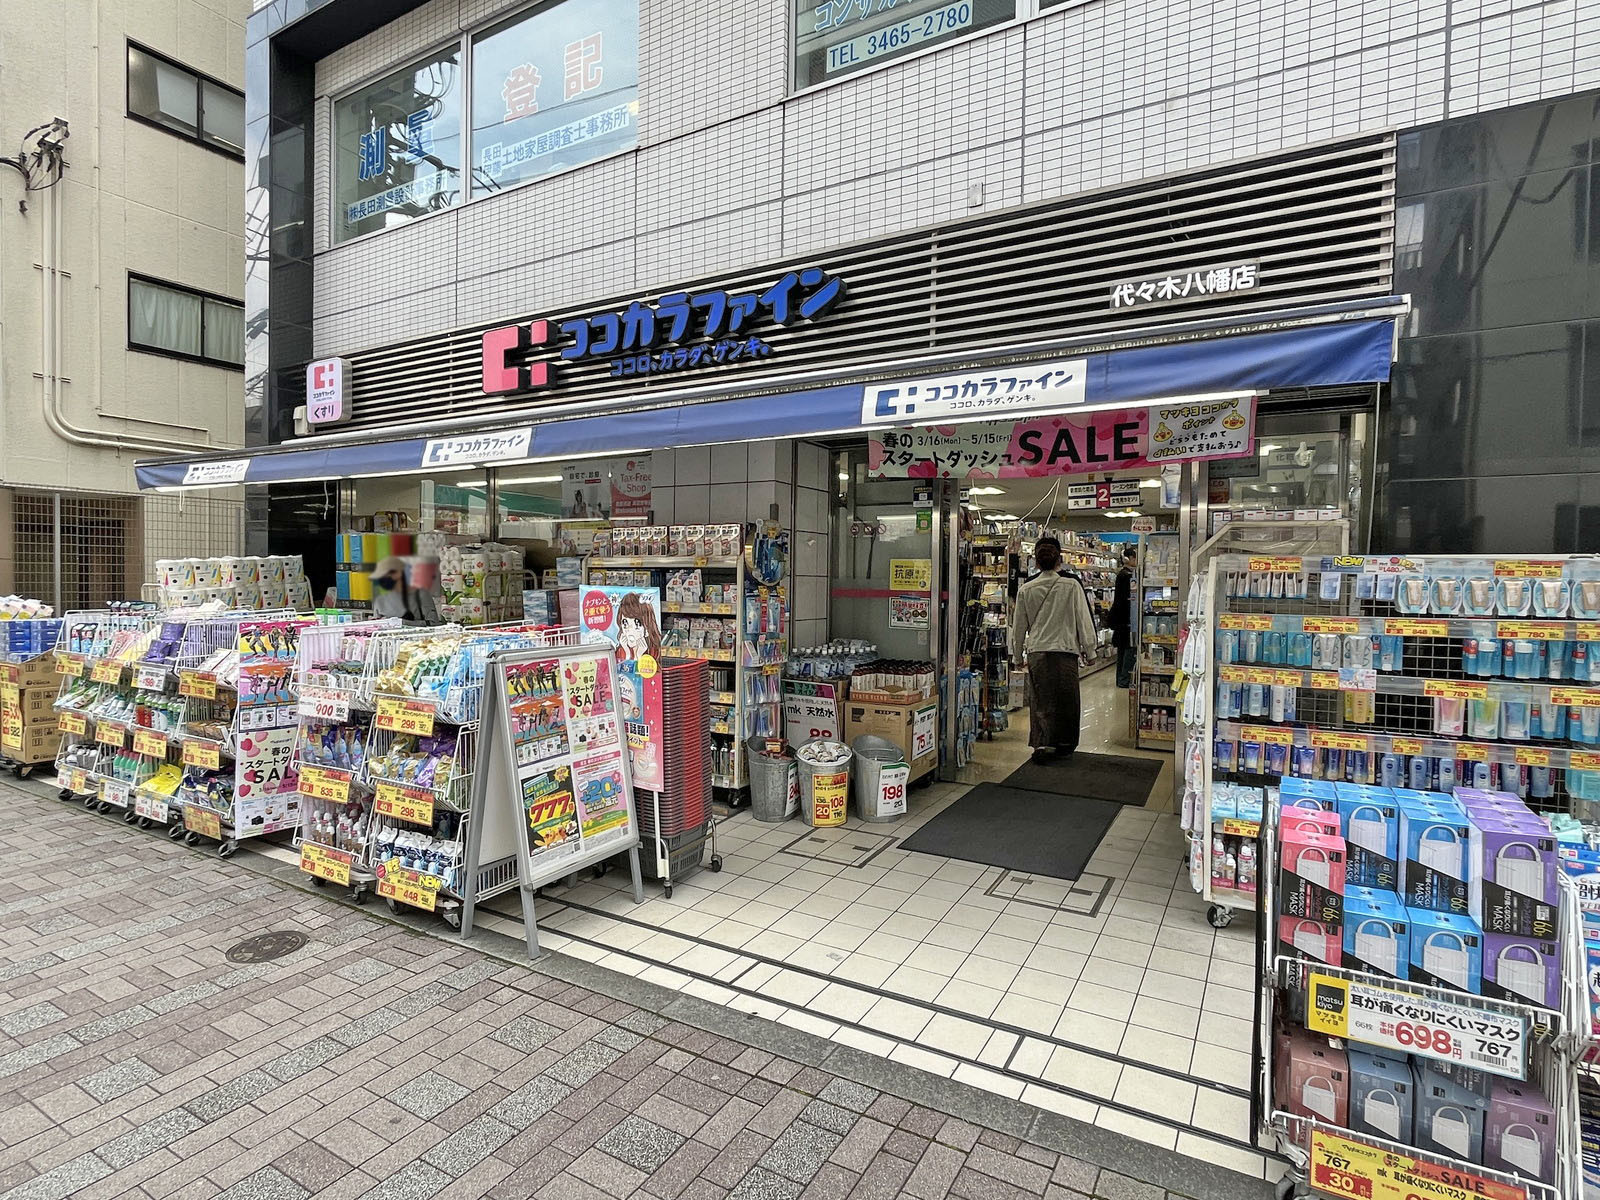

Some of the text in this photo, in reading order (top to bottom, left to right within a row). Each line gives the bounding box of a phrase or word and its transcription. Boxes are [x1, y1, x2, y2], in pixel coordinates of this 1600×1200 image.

[829, 3, 970, 67] TEL 3465-2780
[1112, 264, 1257, 309] 代々木八幡店
[561, 268, 846, 360] ココカラファイン
[610, 337, 774, 378] ココロ、カラダ、ゲンキ。
[924, 369, 1073, 403] ココカラファイン
[949, 394, 1037, 410] ココロ、カラダ、ゲンキ。
[314, 404, 334, 419] くすり
[454, 433, 526, 454] ココカラファイン
[882, 432, 913, 448] 春の
[1018, 421, 1141, 466] SALE
[882, 447, 1017, 469] スタートダッシュ
[626, 483, 647, 494] Shop
[1098, 488, 1109, 502] 2
[1250, 562, 1266, 570] 159
[1333, 556, 1364, 567] NEW
[575, 690, 607, 708] SALE
[315, 703, 334, 717] 900
[787, 705, 835, 718] mk 天然水
[400, 718, 416, 730] 298
[272, 746, 291, 757] 春の
[244, 756, 294, 770] スタートダ
[320, 786, 334, 797] 835
[881, 784, 903, 800] 198
[530, 794, 571, 825] 777
[816, 806, 830, 815] 20
[830, 796, 845, 809] 108
[400, 806, 415, 818] 298
[322, 865, 335, 877] 799
[1345, 859, 1355, 882] MASK
[403, 890, 419, 902] 448
[1414, 882, 1425, 906] MASK
[1289, 891, 1299, 916] MASK
[1492, 904, 1504, 932] MASK
[1316, 994, 1344, 1006] matsu
[1316, 1001, 1333, 1011] kiyo
[1315, 1010, 1345, 1022] マツキヨ
[1319, 1017, 1340, 1027] イイヨ
[1350, 993, 1521, 1041] 耳が痛くなりにくいマスク
[1395, 1021, 1463, 1060] 698 円
[1475, 1038, 1513, 1058] 767
[1323, 1153, 1352, 1171] 767
[1386, 1159, 1440, 1180] スタートダッシュ
[1328, 1172, 1355, 1191] 30
[1393, 1171, 1467, 1200] 耳が痛くなりにくいマスク
[1440, 1171, 1486, 1194] SALE
